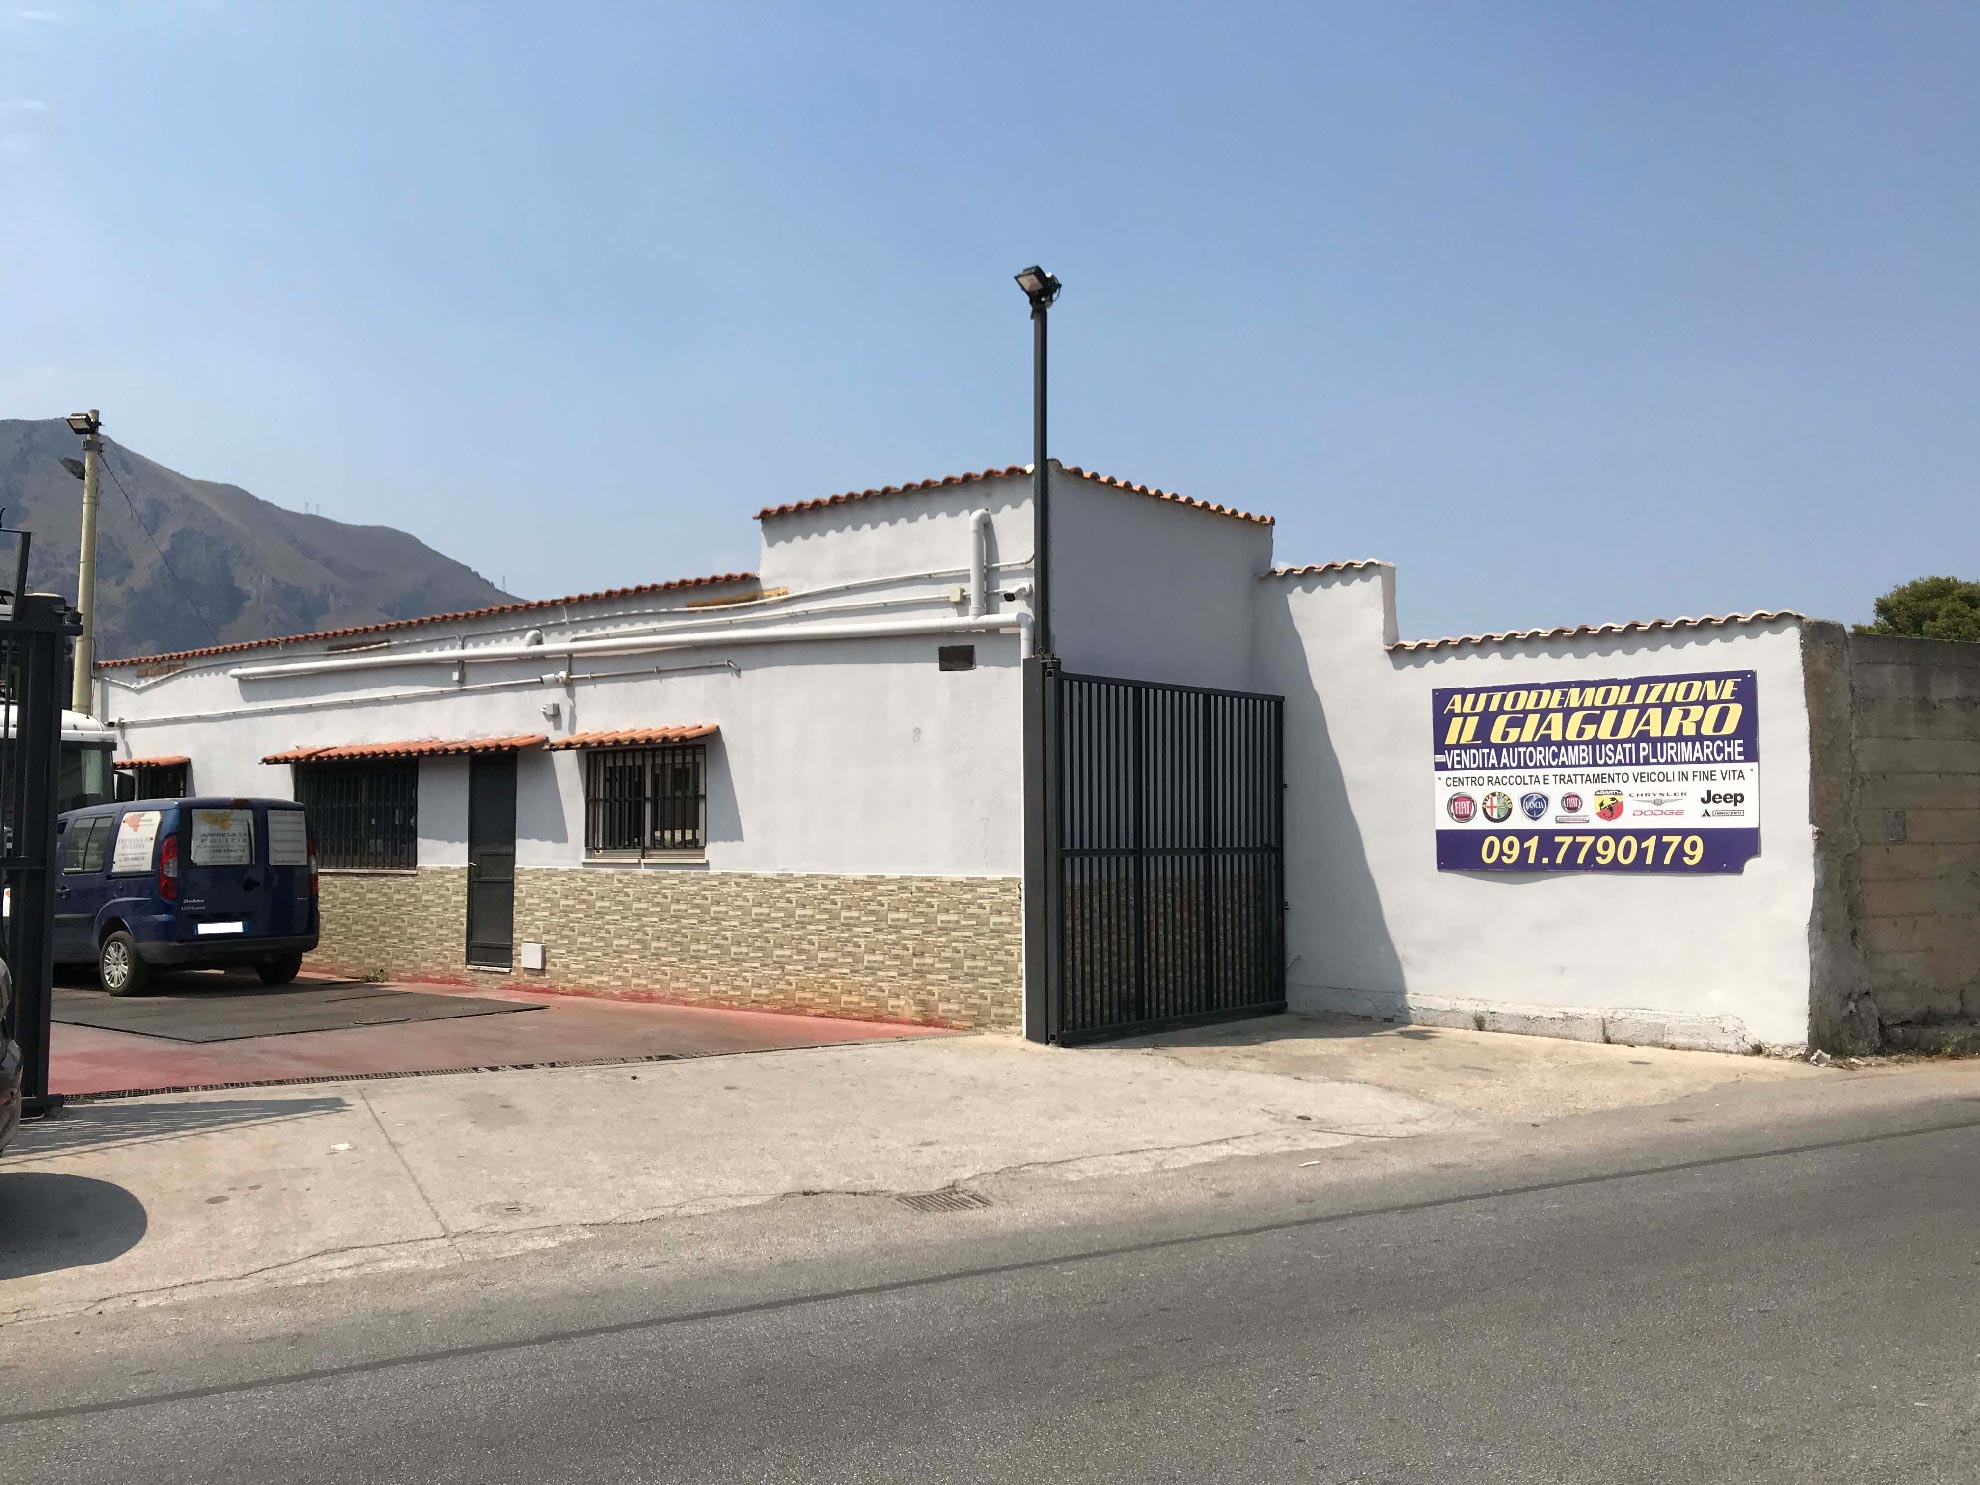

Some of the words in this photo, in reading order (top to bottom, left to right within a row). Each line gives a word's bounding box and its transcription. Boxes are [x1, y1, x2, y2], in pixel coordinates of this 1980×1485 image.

[1444, 679, 1742, 714] AUTODEMOLIZIONE
[1444, 715, 1482, 745] IL
[1490, 703, 1743, 744] GIAGUARO
[1445, 748, 1498, 769] VENDITA
[1500, 745, 1592, 768] AUTORICAMBI
[1596, 743, 1636, 765] USATI
[1640, 739, 1744, 763] PLURIMARCHE
[1445, 776, 1485, 787] CENTRO
[1487, 774, 1540, 786] RACCOLTA
[1543, 774, 1549, 785] E
[1552, 772, 1629, 785] TRATTAMENTO
[1632, 771, 1675, 783] VEICOLI
[1678, 771, 1689, 782] IN
[1692, 770, 1717, 781] FINE
[1720, 769, 1745, 781] VITA
[1454, 801, 1470, 815] FIAT
[1525, 801, 1545, 810] LANCIA
[1701, 790, 1745, 806] Jeep
[1481, 835, 1704, 866] 091.7790179
